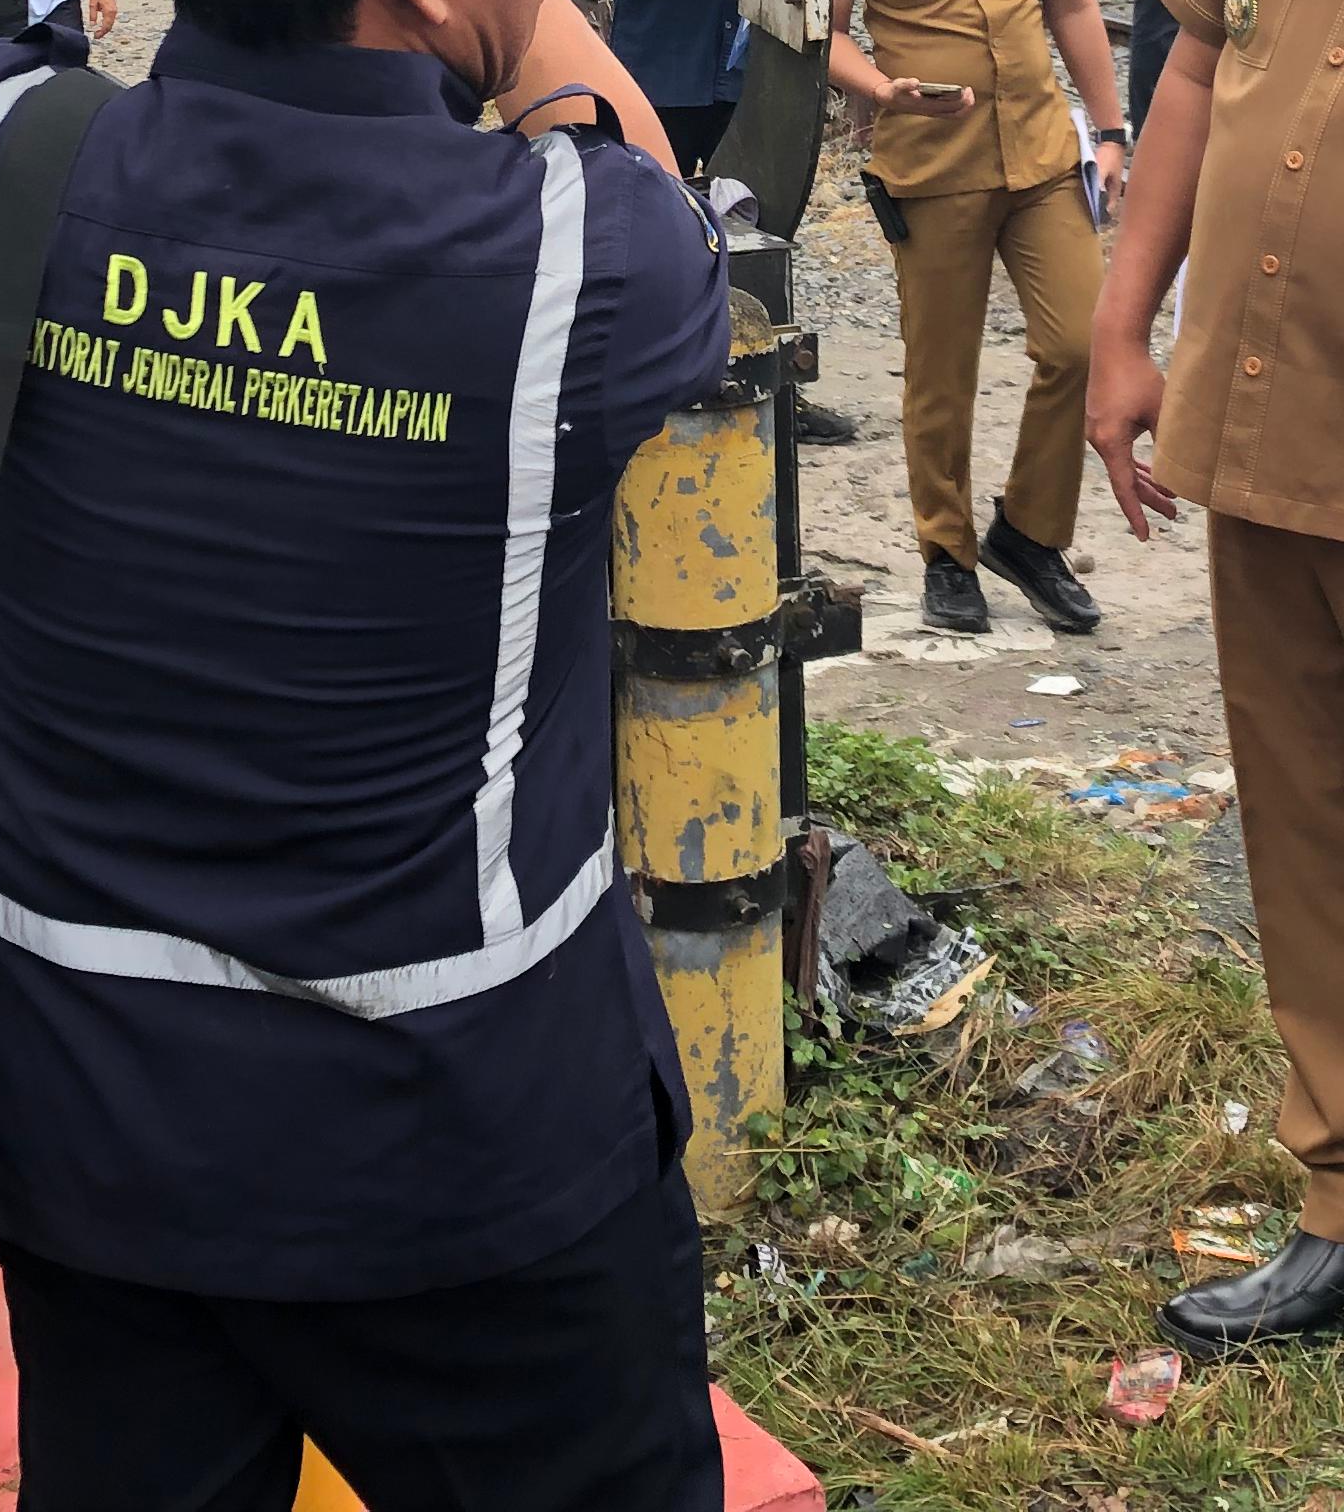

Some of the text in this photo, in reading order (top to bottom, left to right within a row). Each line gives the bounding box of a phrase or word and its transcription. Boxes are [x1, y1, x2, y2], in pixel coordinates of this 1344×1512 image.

[27, 317, 452, 443] KTORAT JENDERAL PERKERETAAPIAN
